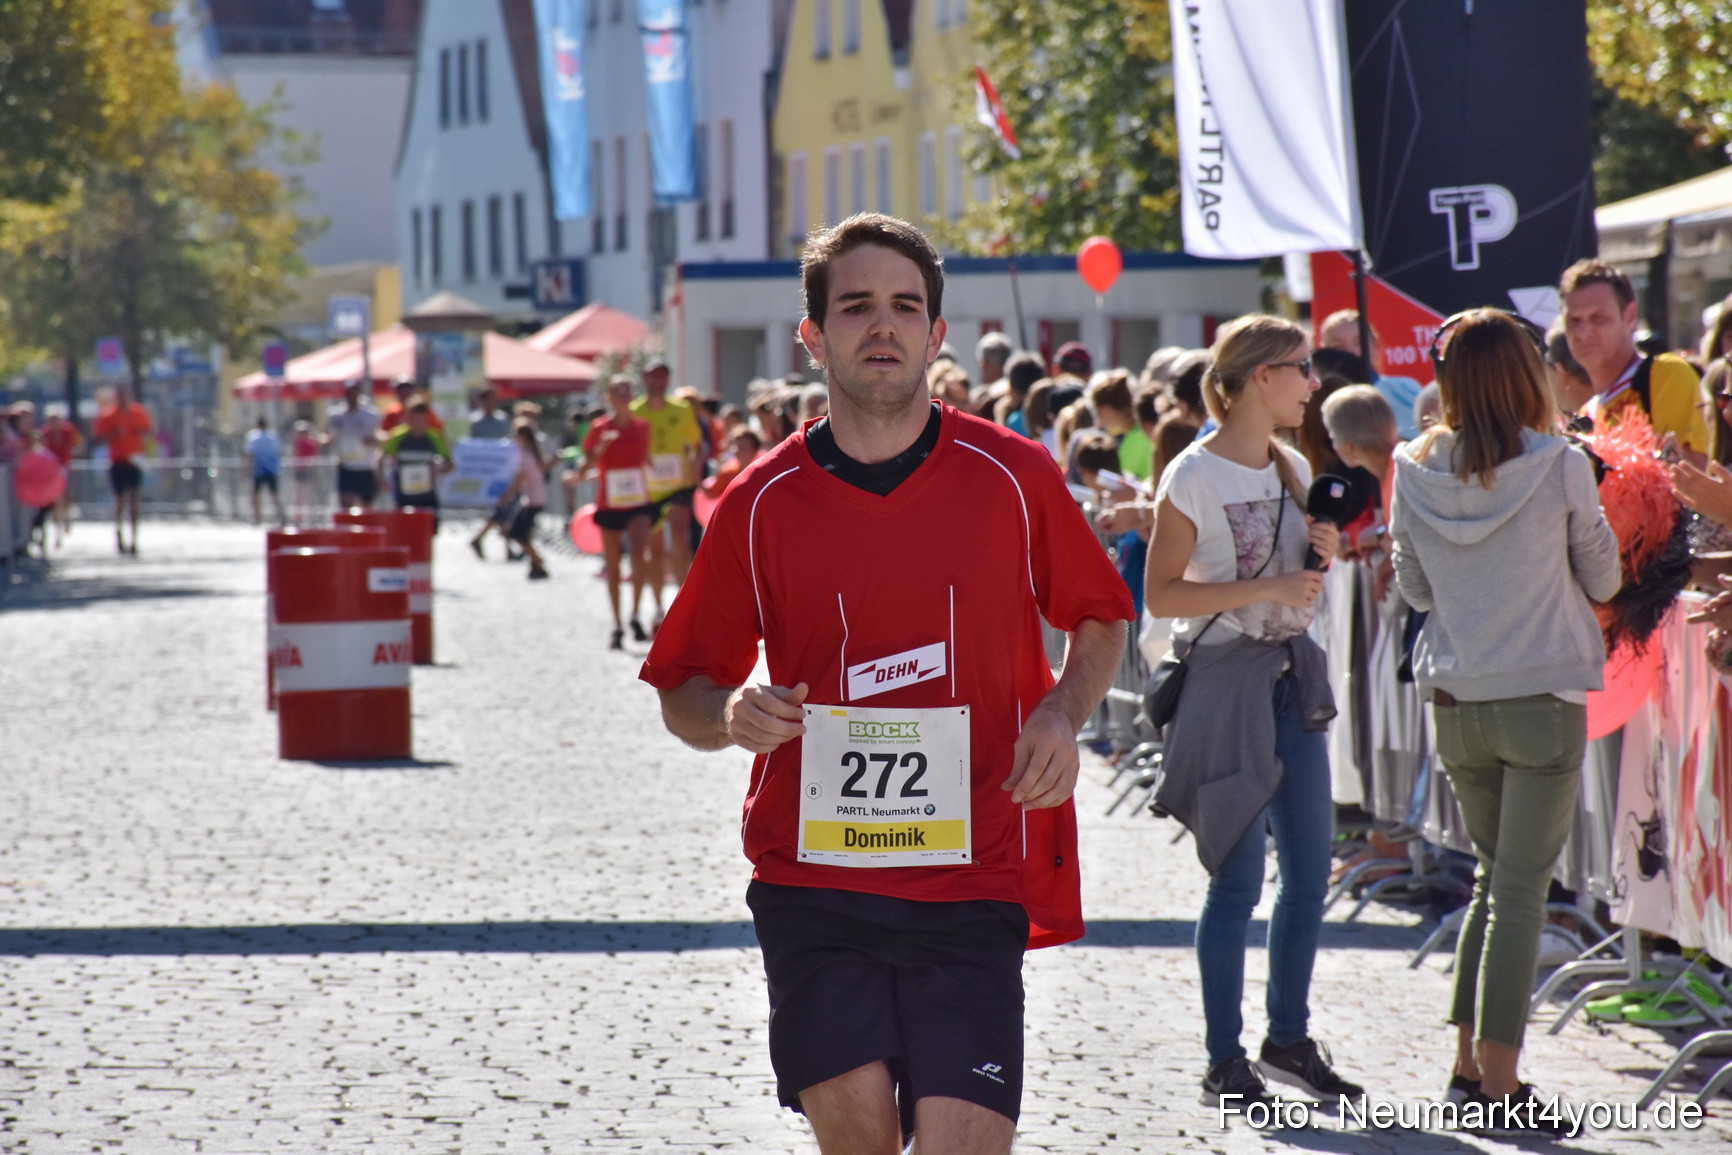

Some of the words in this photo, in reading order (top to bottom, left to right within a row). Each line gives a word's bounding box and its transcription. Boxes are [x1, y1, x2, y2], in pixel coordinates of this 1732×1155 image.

[1384, 345, 1417, 366] 100
[875, 659, 919, 684] DEHN
[848, 721, 920, 738] BOCK
[841, 751, 928, 799] 272
[836, 806, 869, 816] PARTL
[871, 806, 920, 816] Neumarkt
[844, 827, 926, 848] Dominik
